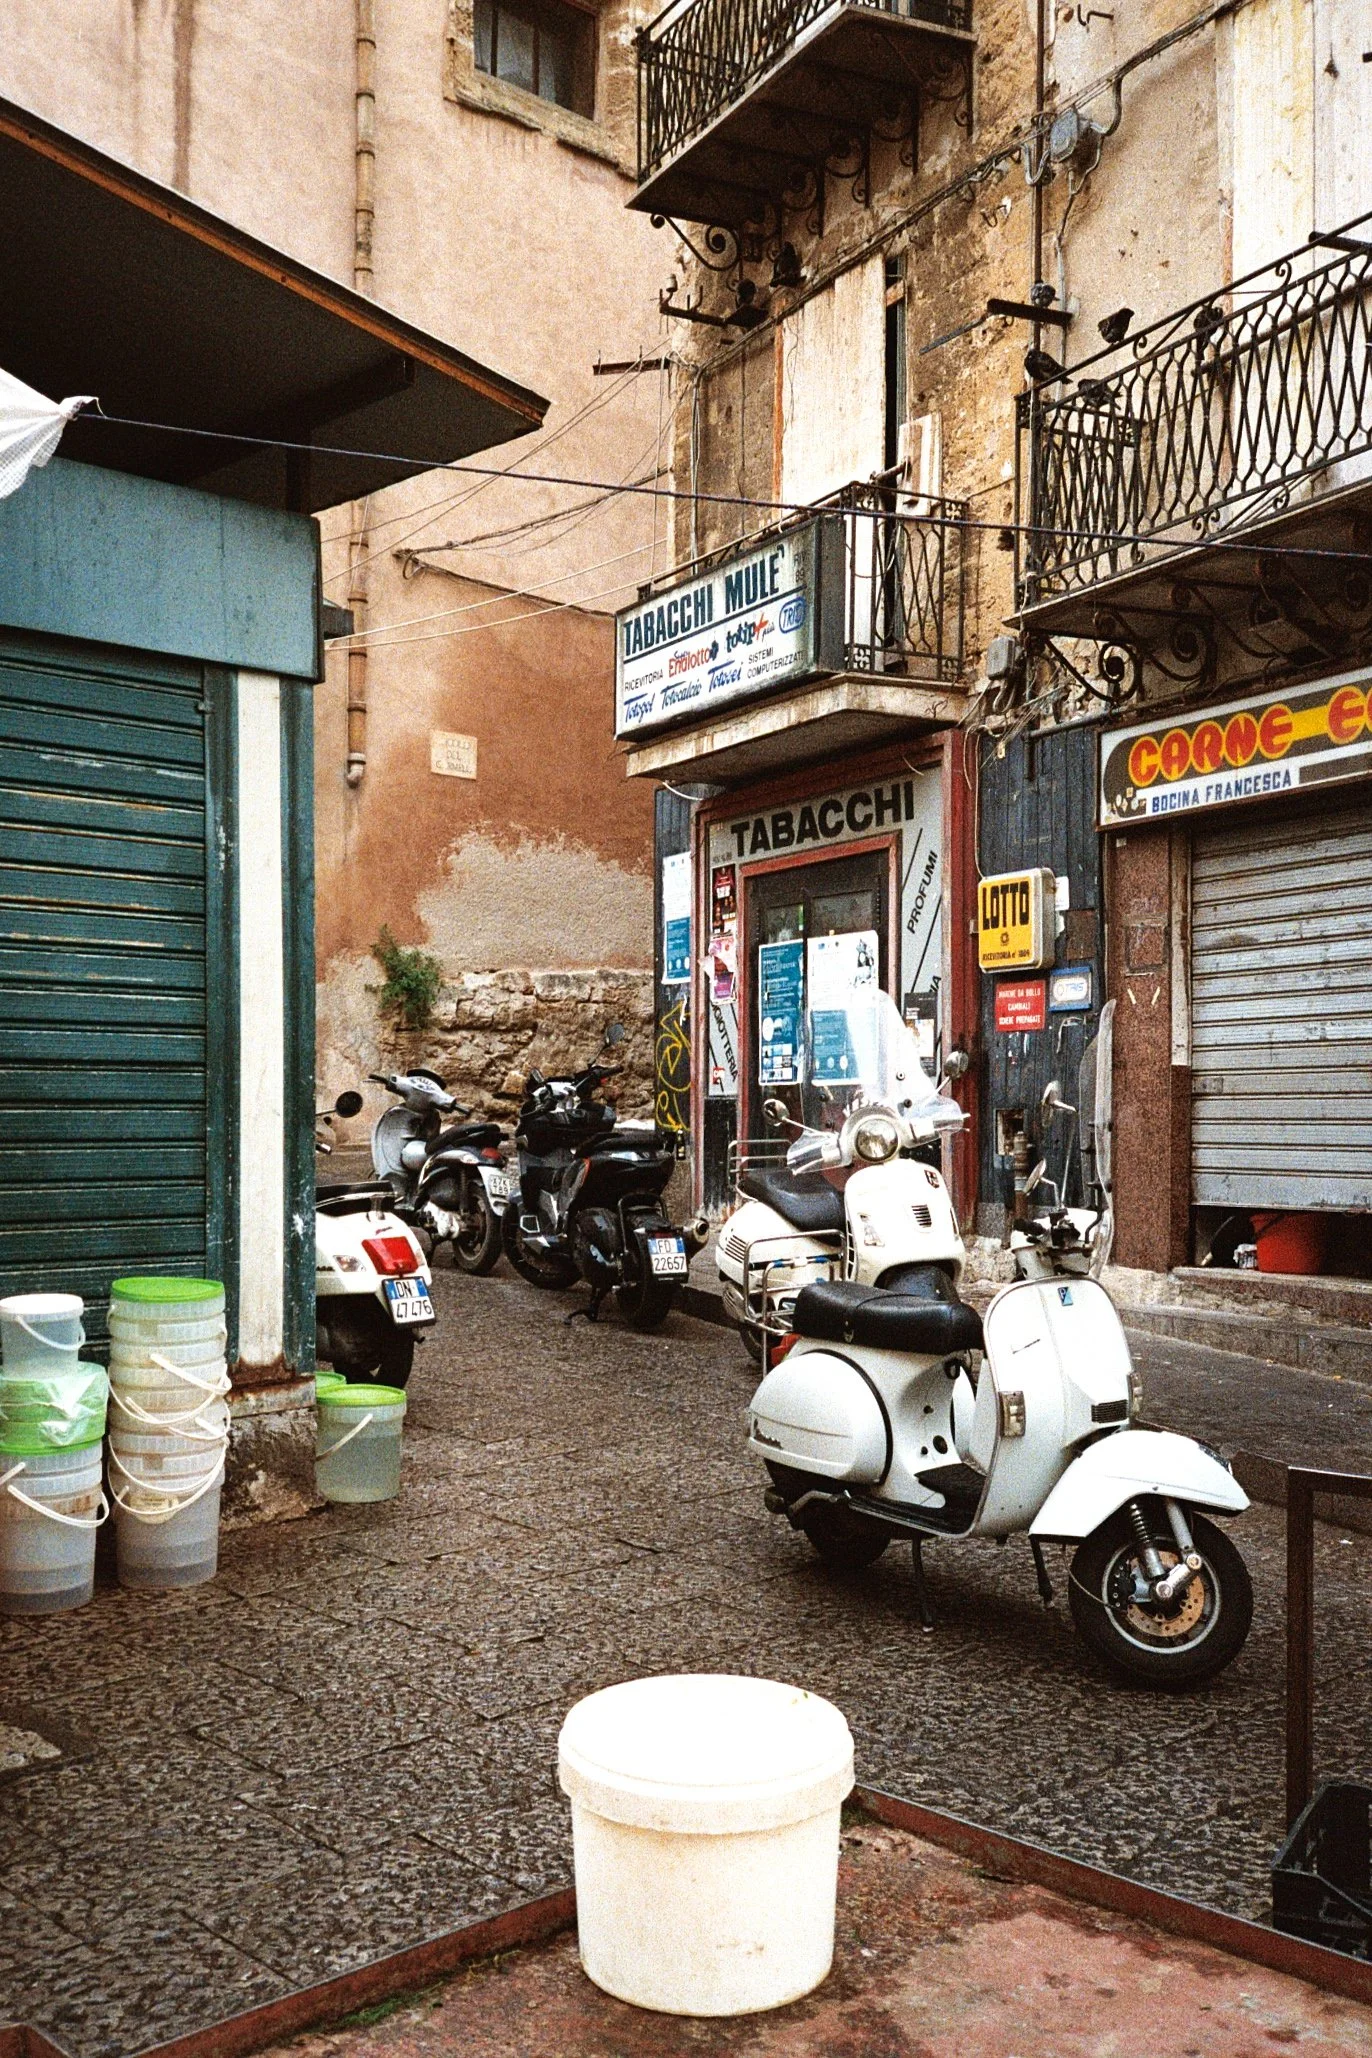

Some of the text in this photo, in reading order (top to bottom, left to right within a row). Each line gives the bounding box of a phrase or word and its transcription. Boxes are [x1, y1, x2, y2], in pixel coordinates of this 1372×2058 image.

[623, 585, 714, 657] TABACCHI
[624, 669, 664, 692] RICEVITORIA
[668, 648, 712, 678] Enalotto
[748, 646, 774, 664] SISTEMI
[1129, 685, 1372, 787] CARNE E
[1152, 768, 1293, 814] BOCINA FRANCESCA
[731, 781, 915, 857] TABACCHI
[906, 850, 938, 935] PROFUMI
[982, 880, 1030, 931] LOTTO
[653, 1256, 686, 1272] 22657
[395, 1281, 413, 1298] DN
